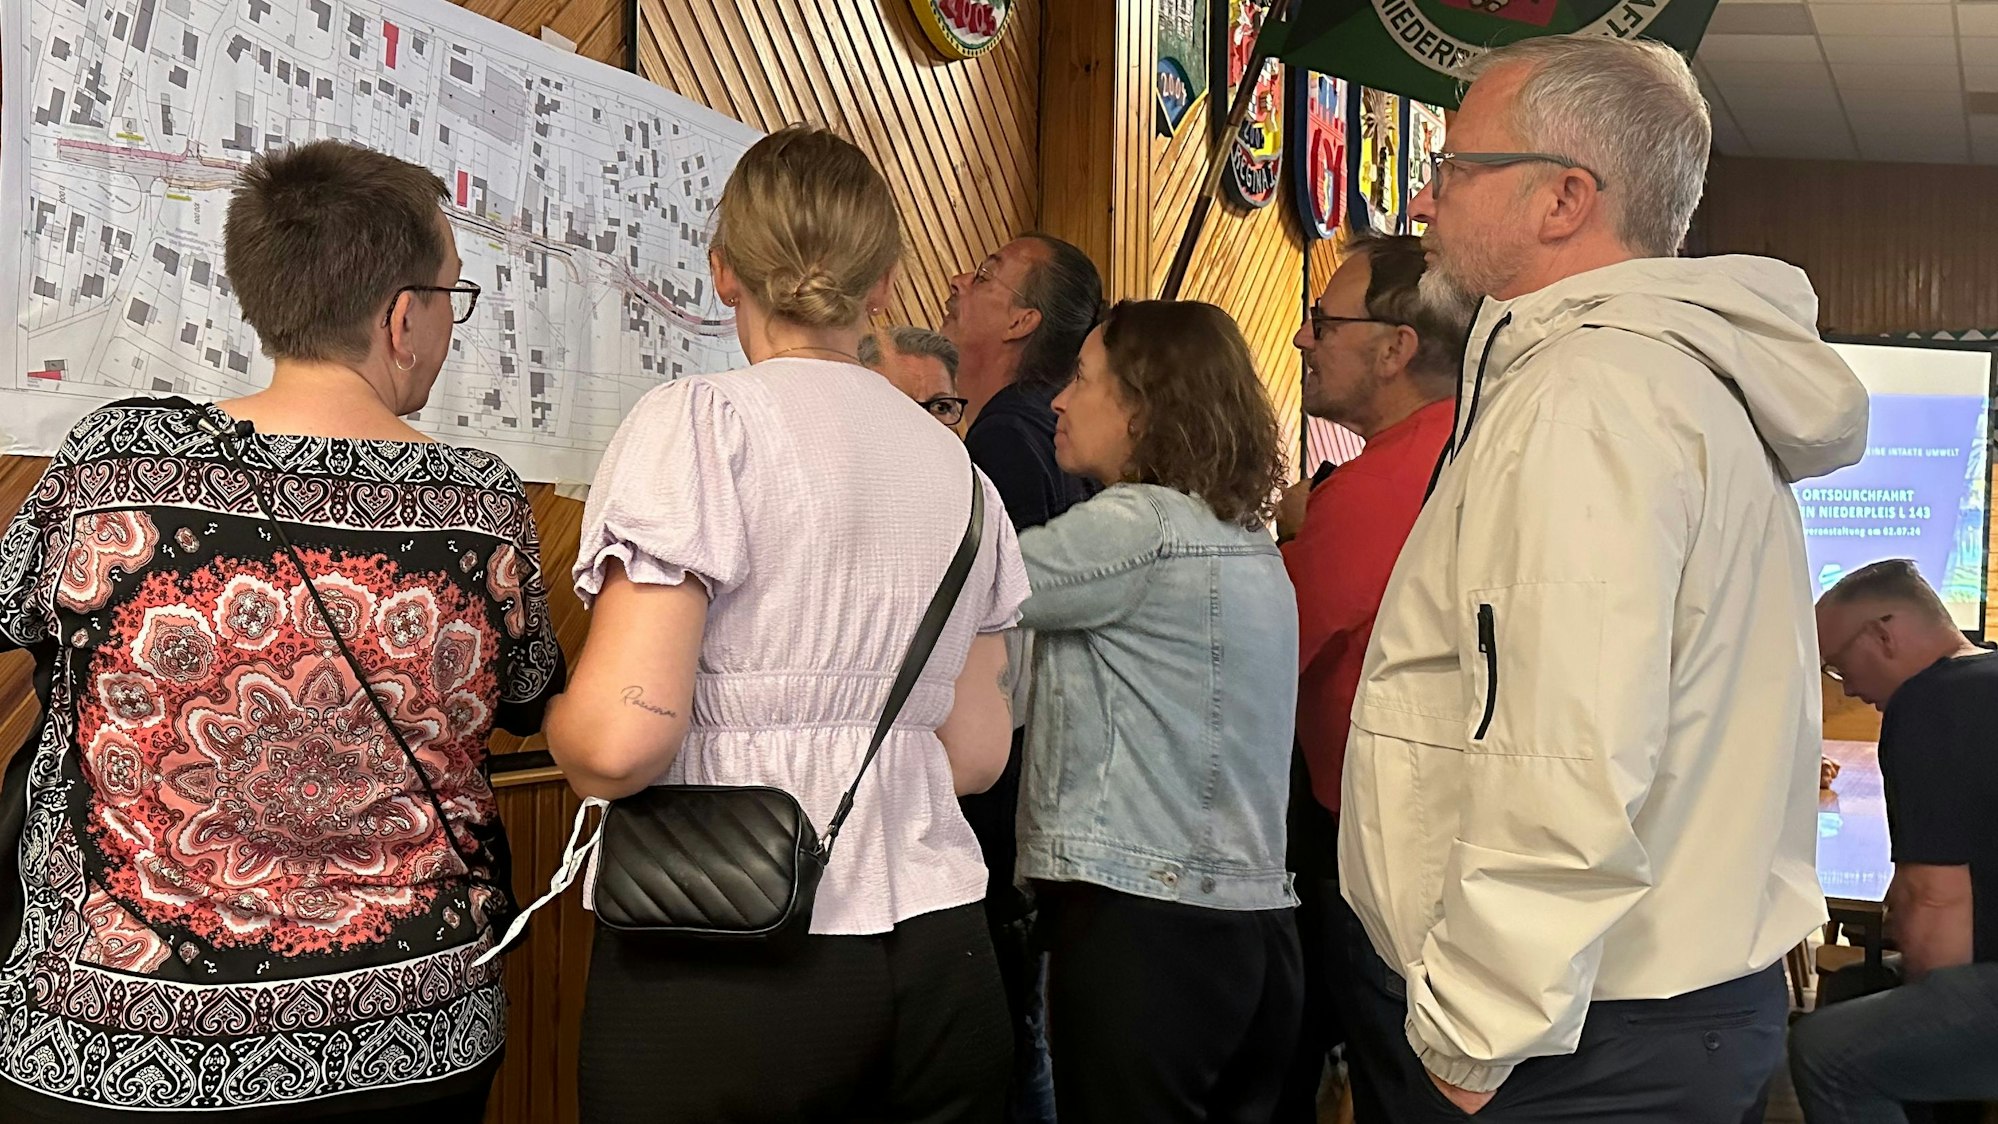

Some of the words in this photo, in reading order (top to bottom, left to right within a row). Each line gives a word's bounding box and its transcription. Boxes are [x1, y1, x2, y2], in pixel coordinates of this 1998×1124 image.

[1888, 447, 1923, 457] INTAKTE
[1925, 447, 1960, 458] UMWELT
[1802, 488, 1915, 503] ORTSDURCHFAHRT
[1819, 505, 1896, 520] NIEDERPLEIS
[1898, 506, 1906, 519] L
[1908, 506, 1931, 520] 143
[1867, 527, 1881, 536] am
